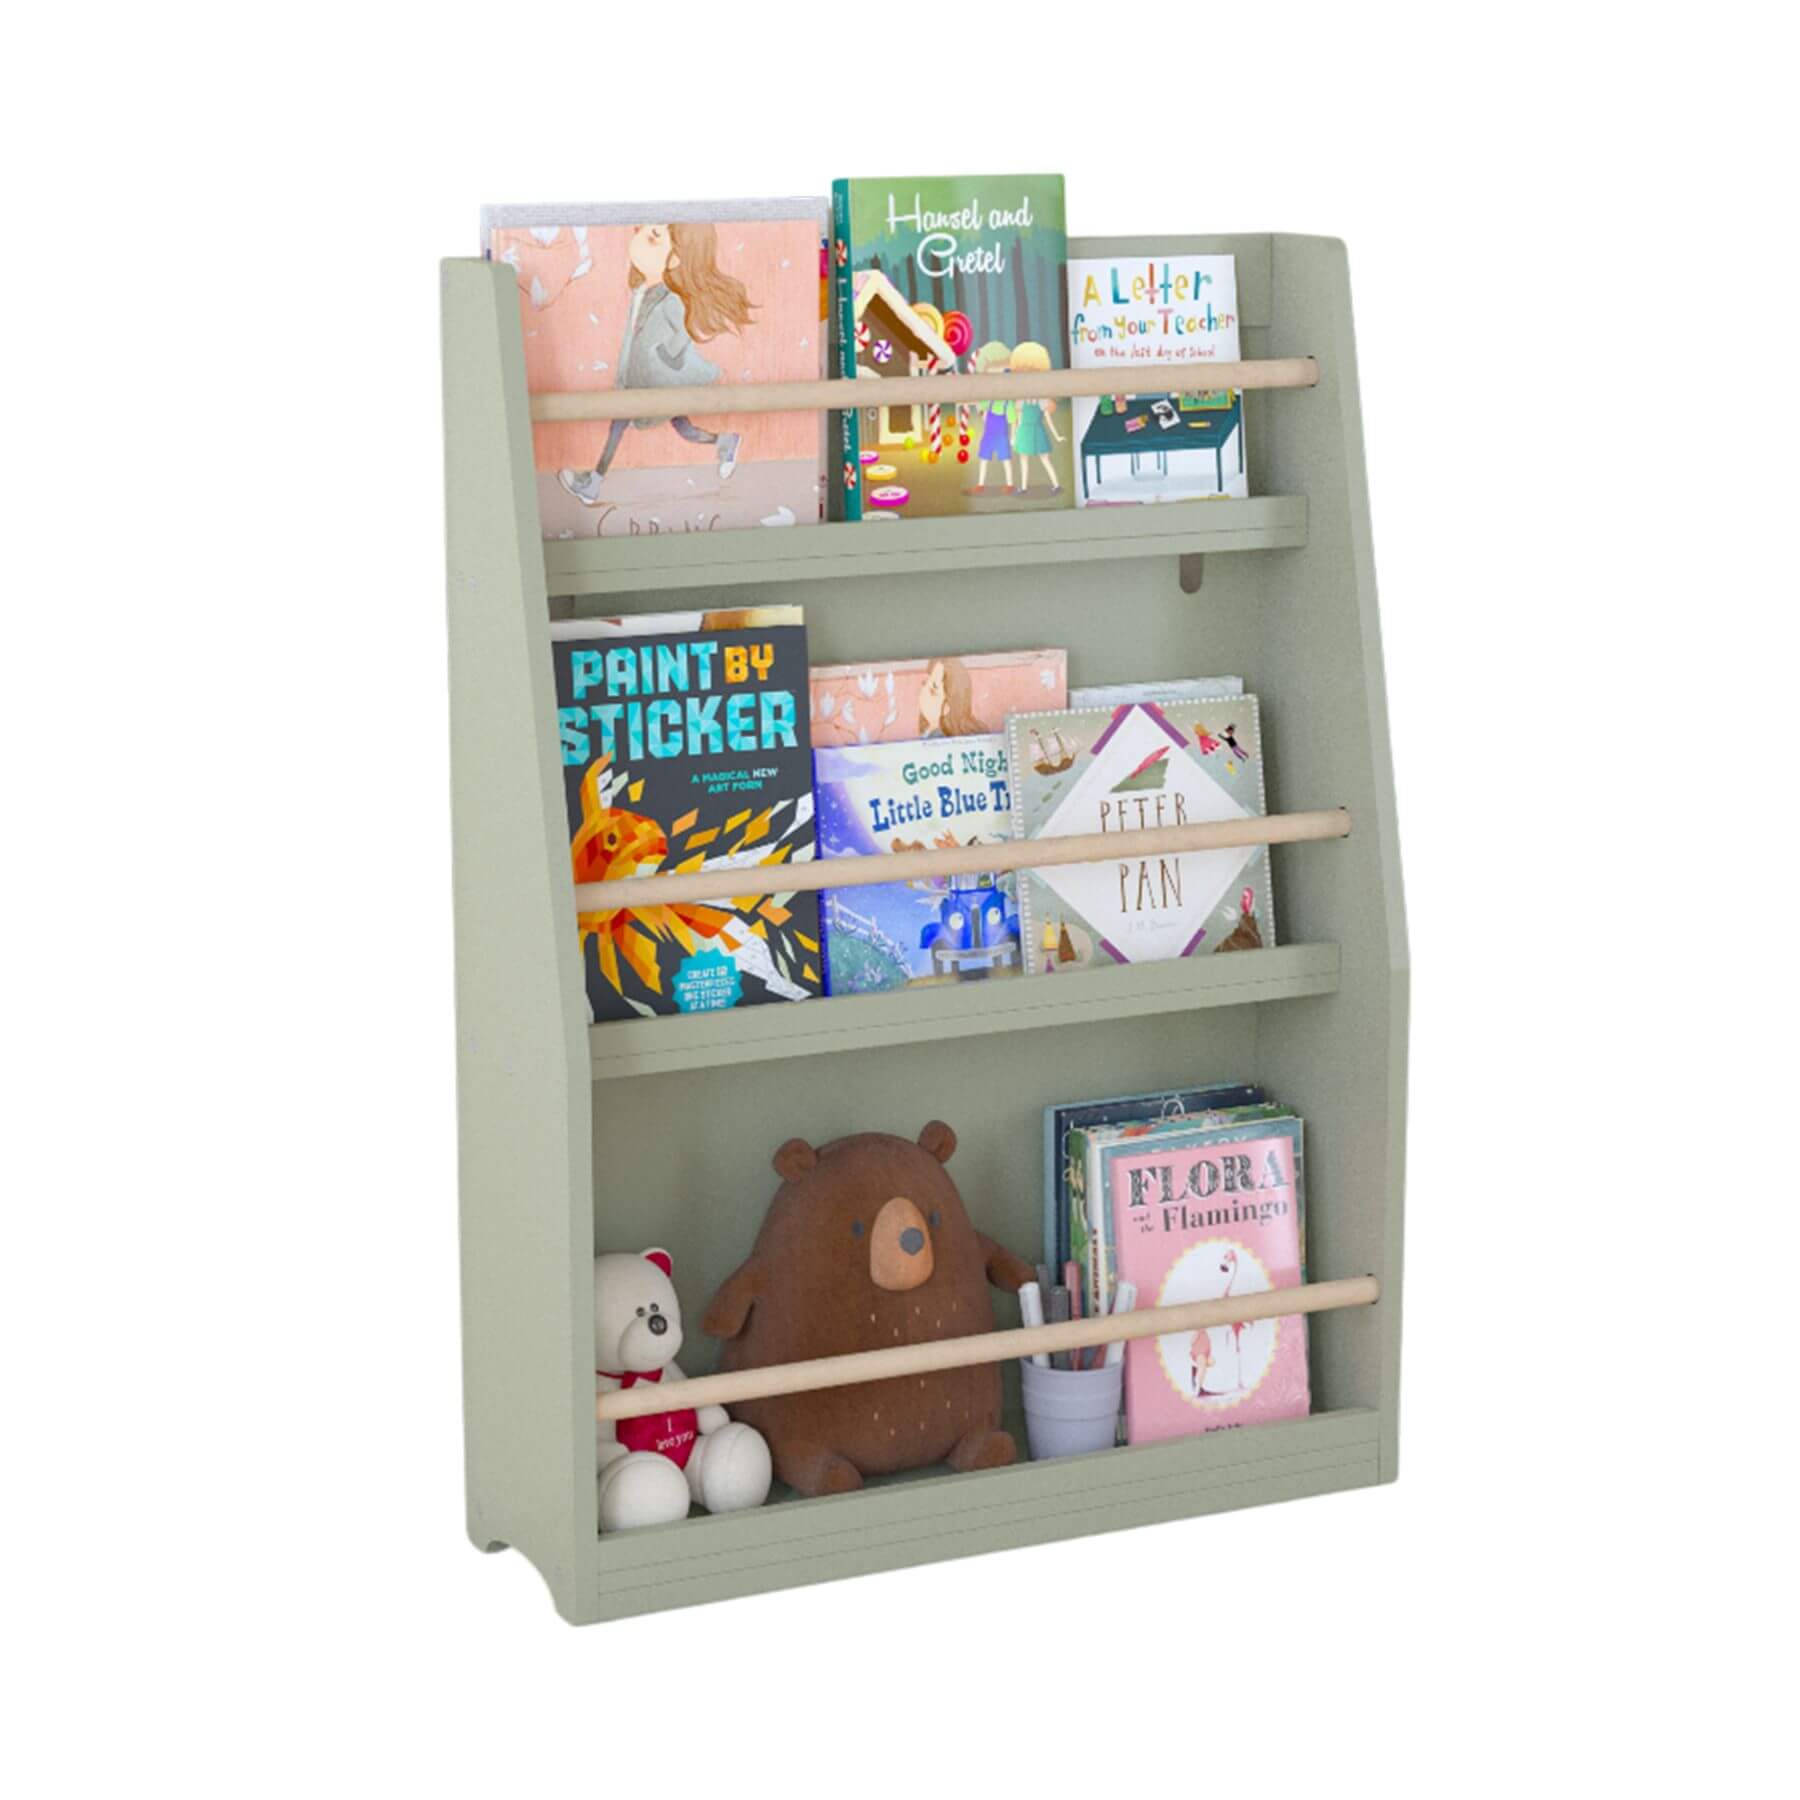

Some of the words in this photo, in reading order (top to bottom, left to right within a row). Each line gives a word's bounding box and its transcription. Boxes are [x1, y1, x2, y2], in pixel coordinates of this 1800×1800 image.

[886, 193, 983, 233] Hansel
[989, 196, 1033, 230] and
[917, 233, 1006, 279] Gretel
[1083, 275, 1102, 308] A
[1111, 263, 1213, 304] Letter
[1072, 313, 1113, 344] from
[1114, 315, 1156, 340] your
[1157, 303, 1235, 335] Teacher
[571, 641, 718, 699] PAINT
[724, 643, 775, 684] BY
[558, 690, 798, 765] STICKER
[691, 773, 700, 784] A
[702, 769, 749, 783] MAGICAL
[752, 766, 778, 778] NEW
[708, 782, 729, 794] ART
[731, 780, 763, 792] FORM
[902, 753, 954, 785] Good
[961, 750, 1008, 778] Nigh
[869, 794, 933, 832] Little
[937, 785, 988, 818] Blue
[1100, 792, 1187, 833] PETER
[1119, 857, 1183, 912] PAN
[1129, 1150, 1289, 1207] FLORA
[1162, 1199, 1288, 1233] Flamingo
[656, 1437, 675, 1450] love
[675, 1431, 694, 1448] you
[667, 1416, 672, 1432] I
